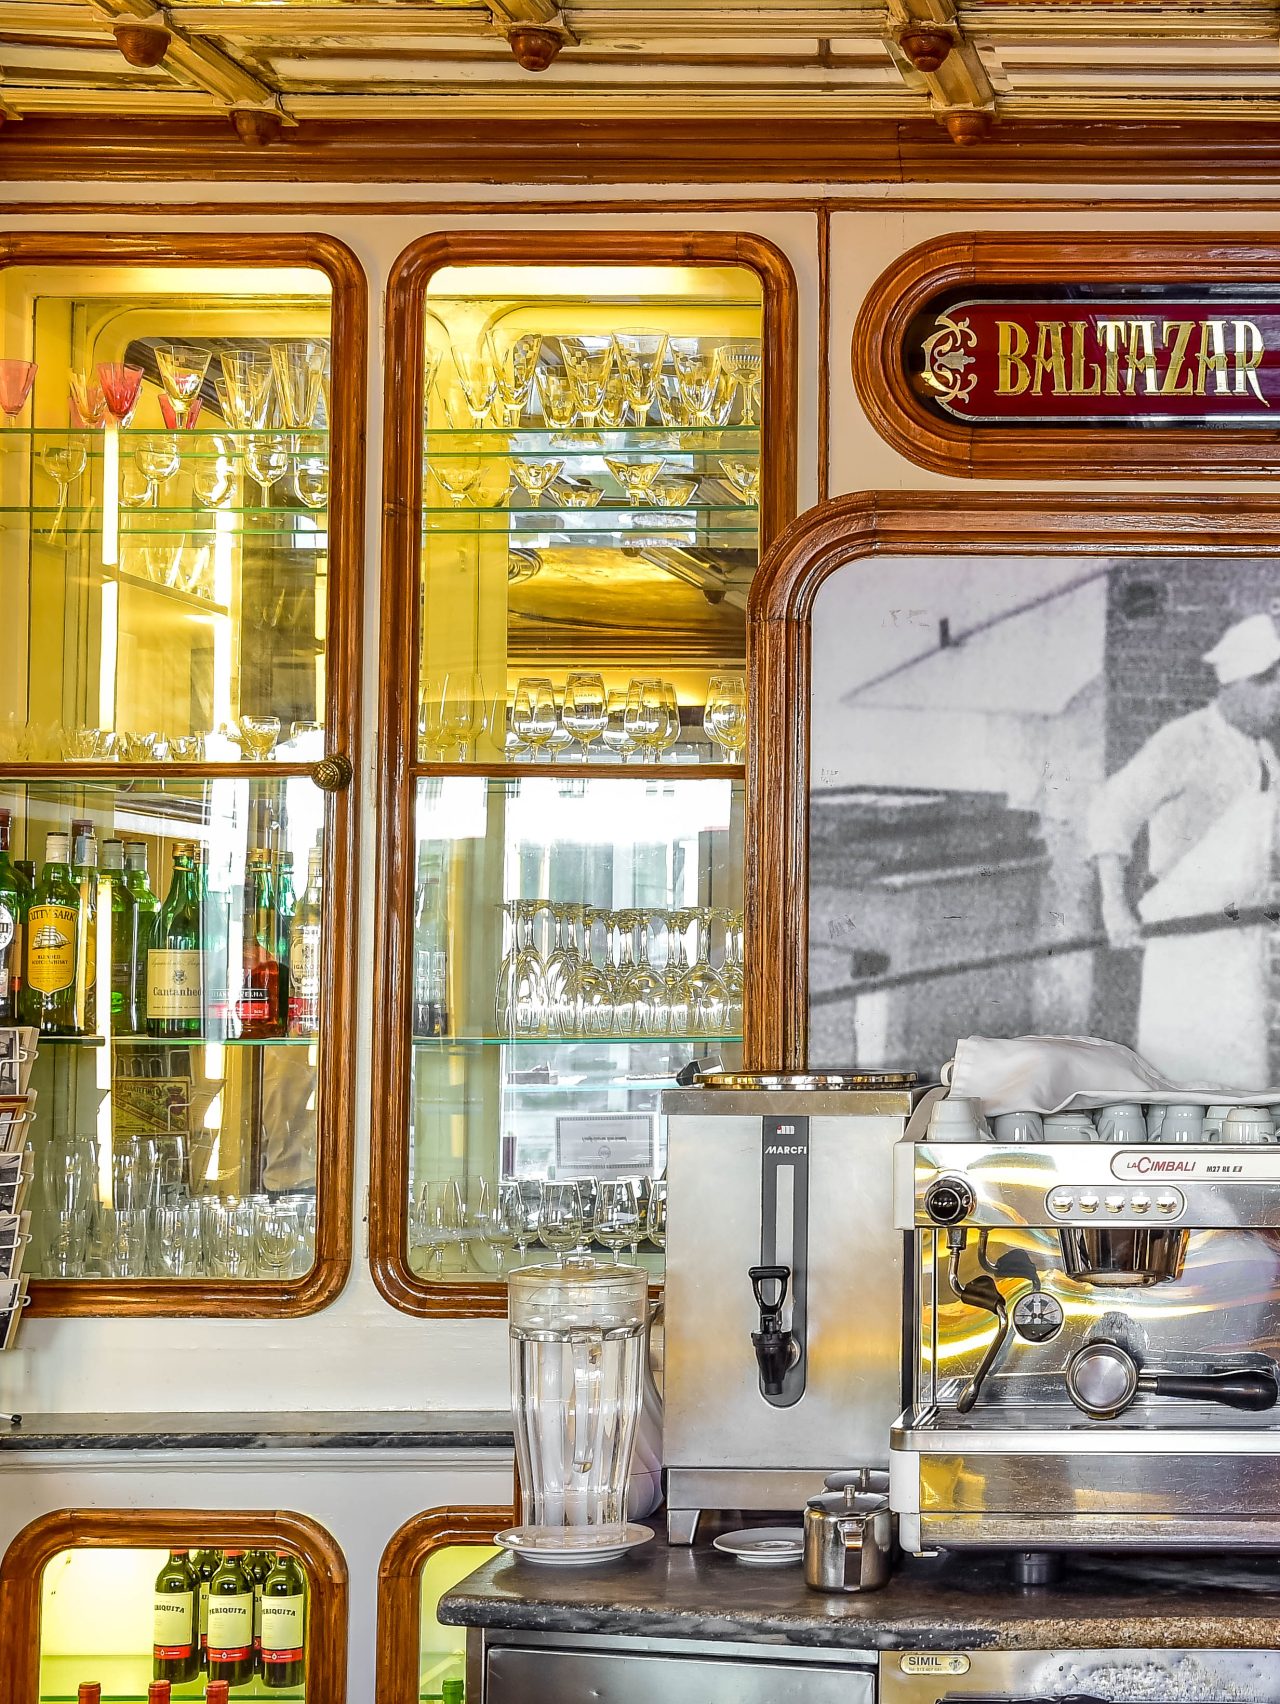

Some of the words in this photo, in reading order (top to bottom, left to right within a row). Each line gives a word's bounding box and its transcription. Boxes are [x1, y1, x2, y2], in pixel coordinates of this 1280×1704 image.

[994, 320, 1270, 407] BALTAZAR
[765, 1146, 807, 1155] MARCFI
[1206, 1165, 1221, 1173] M27
[908, 1656, 942, 1666] SIMIL
